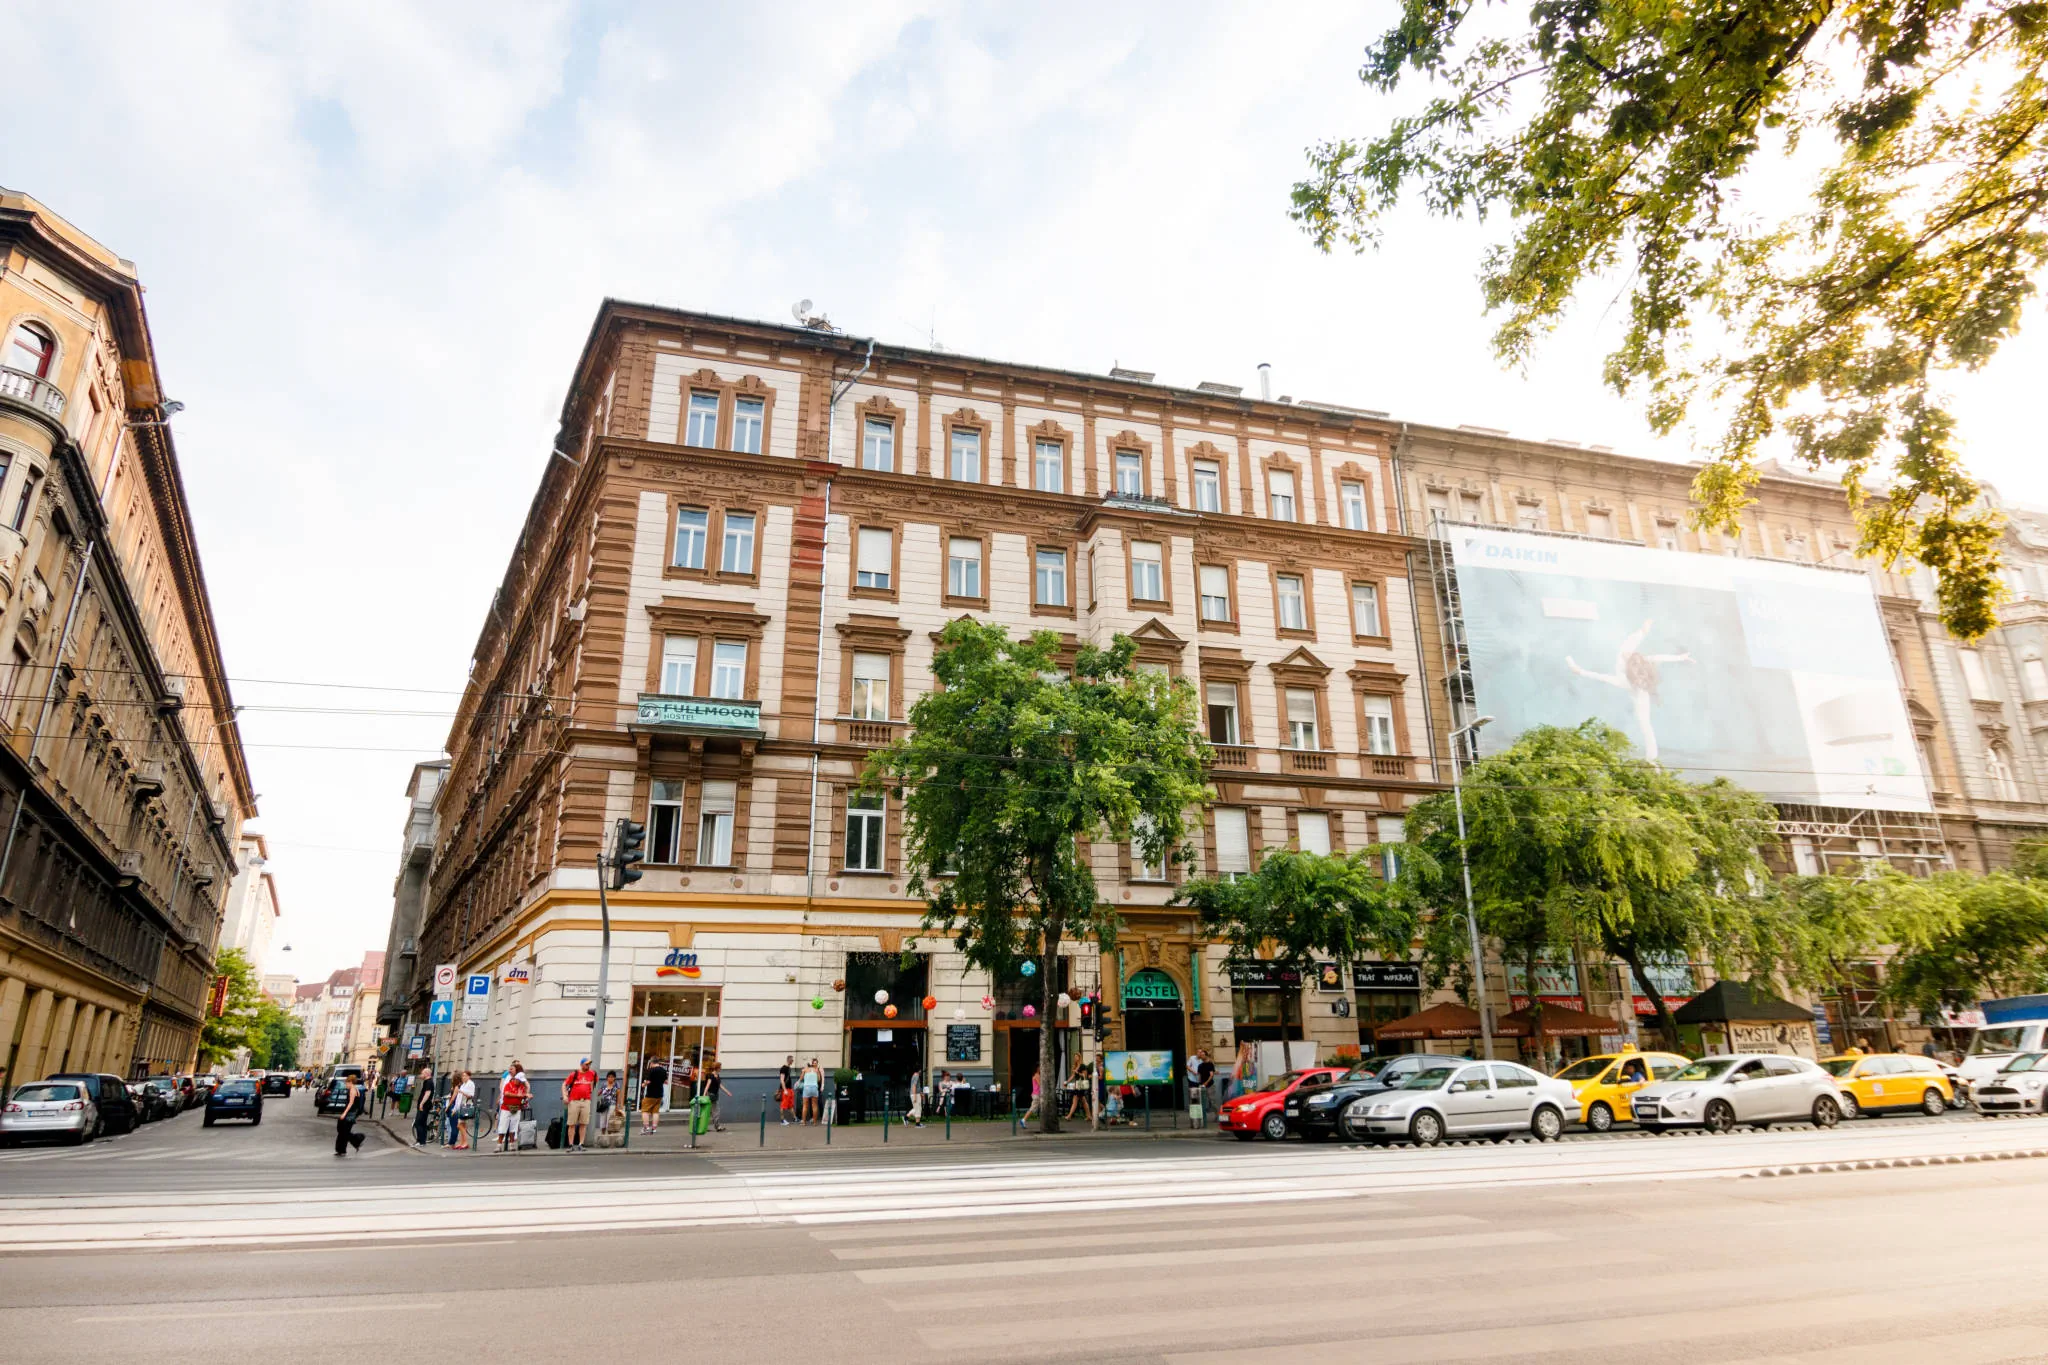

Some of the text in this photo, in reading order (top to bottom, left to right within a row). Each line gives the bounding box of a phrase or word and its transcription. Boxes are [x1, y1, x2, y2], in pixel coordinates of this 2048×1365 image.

[1485, 544, 1558, 564] DAIKIN
[663, 703, 755, 719] FULLMOON
[663, 712, 694, 721] HOSTEL
[665, 948, 697, 967] dm
[509, 967, 528, 978] dm
[472, 979, 485, 992] P
[1125, 985, 1176, 998] HOSTEL
